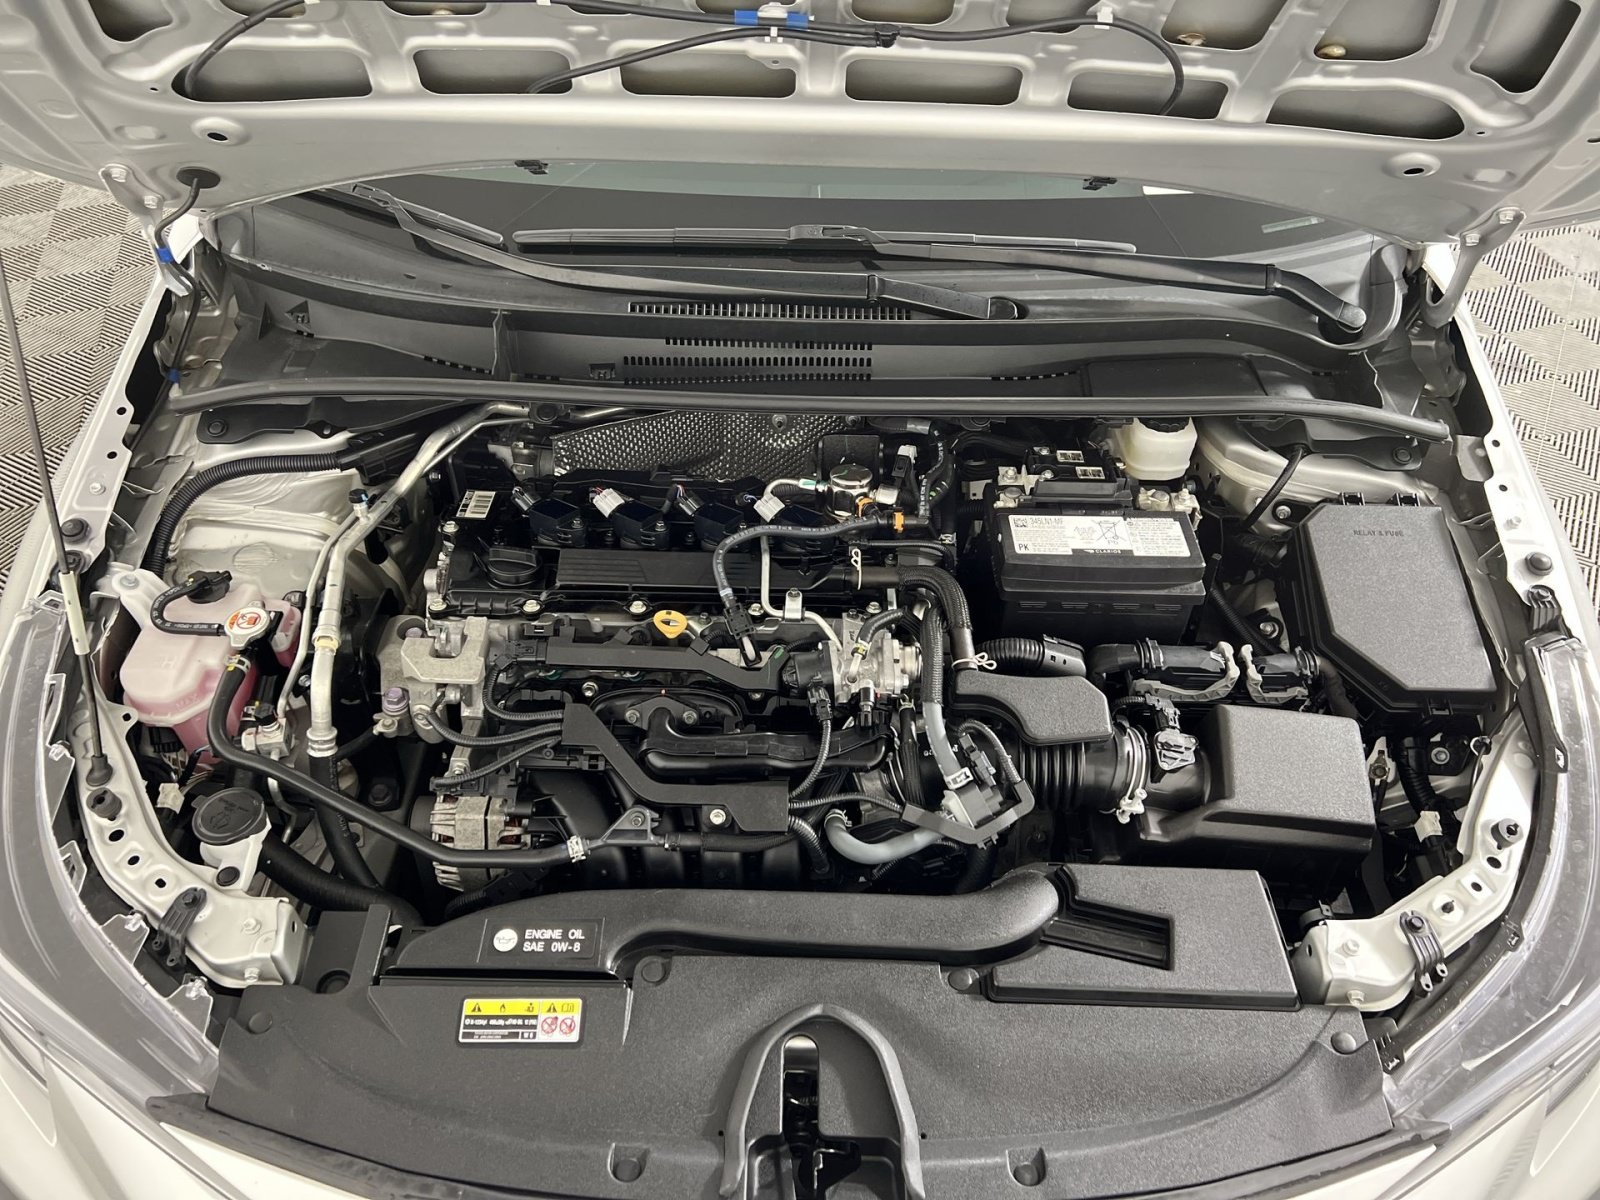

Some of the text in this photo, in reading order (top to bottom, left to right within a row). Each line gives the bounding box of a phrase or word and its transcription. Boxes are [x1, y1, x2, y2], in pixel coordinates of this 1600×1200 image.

[1353, 529, 1376, 537] RELAY
[1018, 543, 1030, 551] PK
[524, 929, 585, 940] ENGINE OIL
[522, 941, 545, 952] SAE
